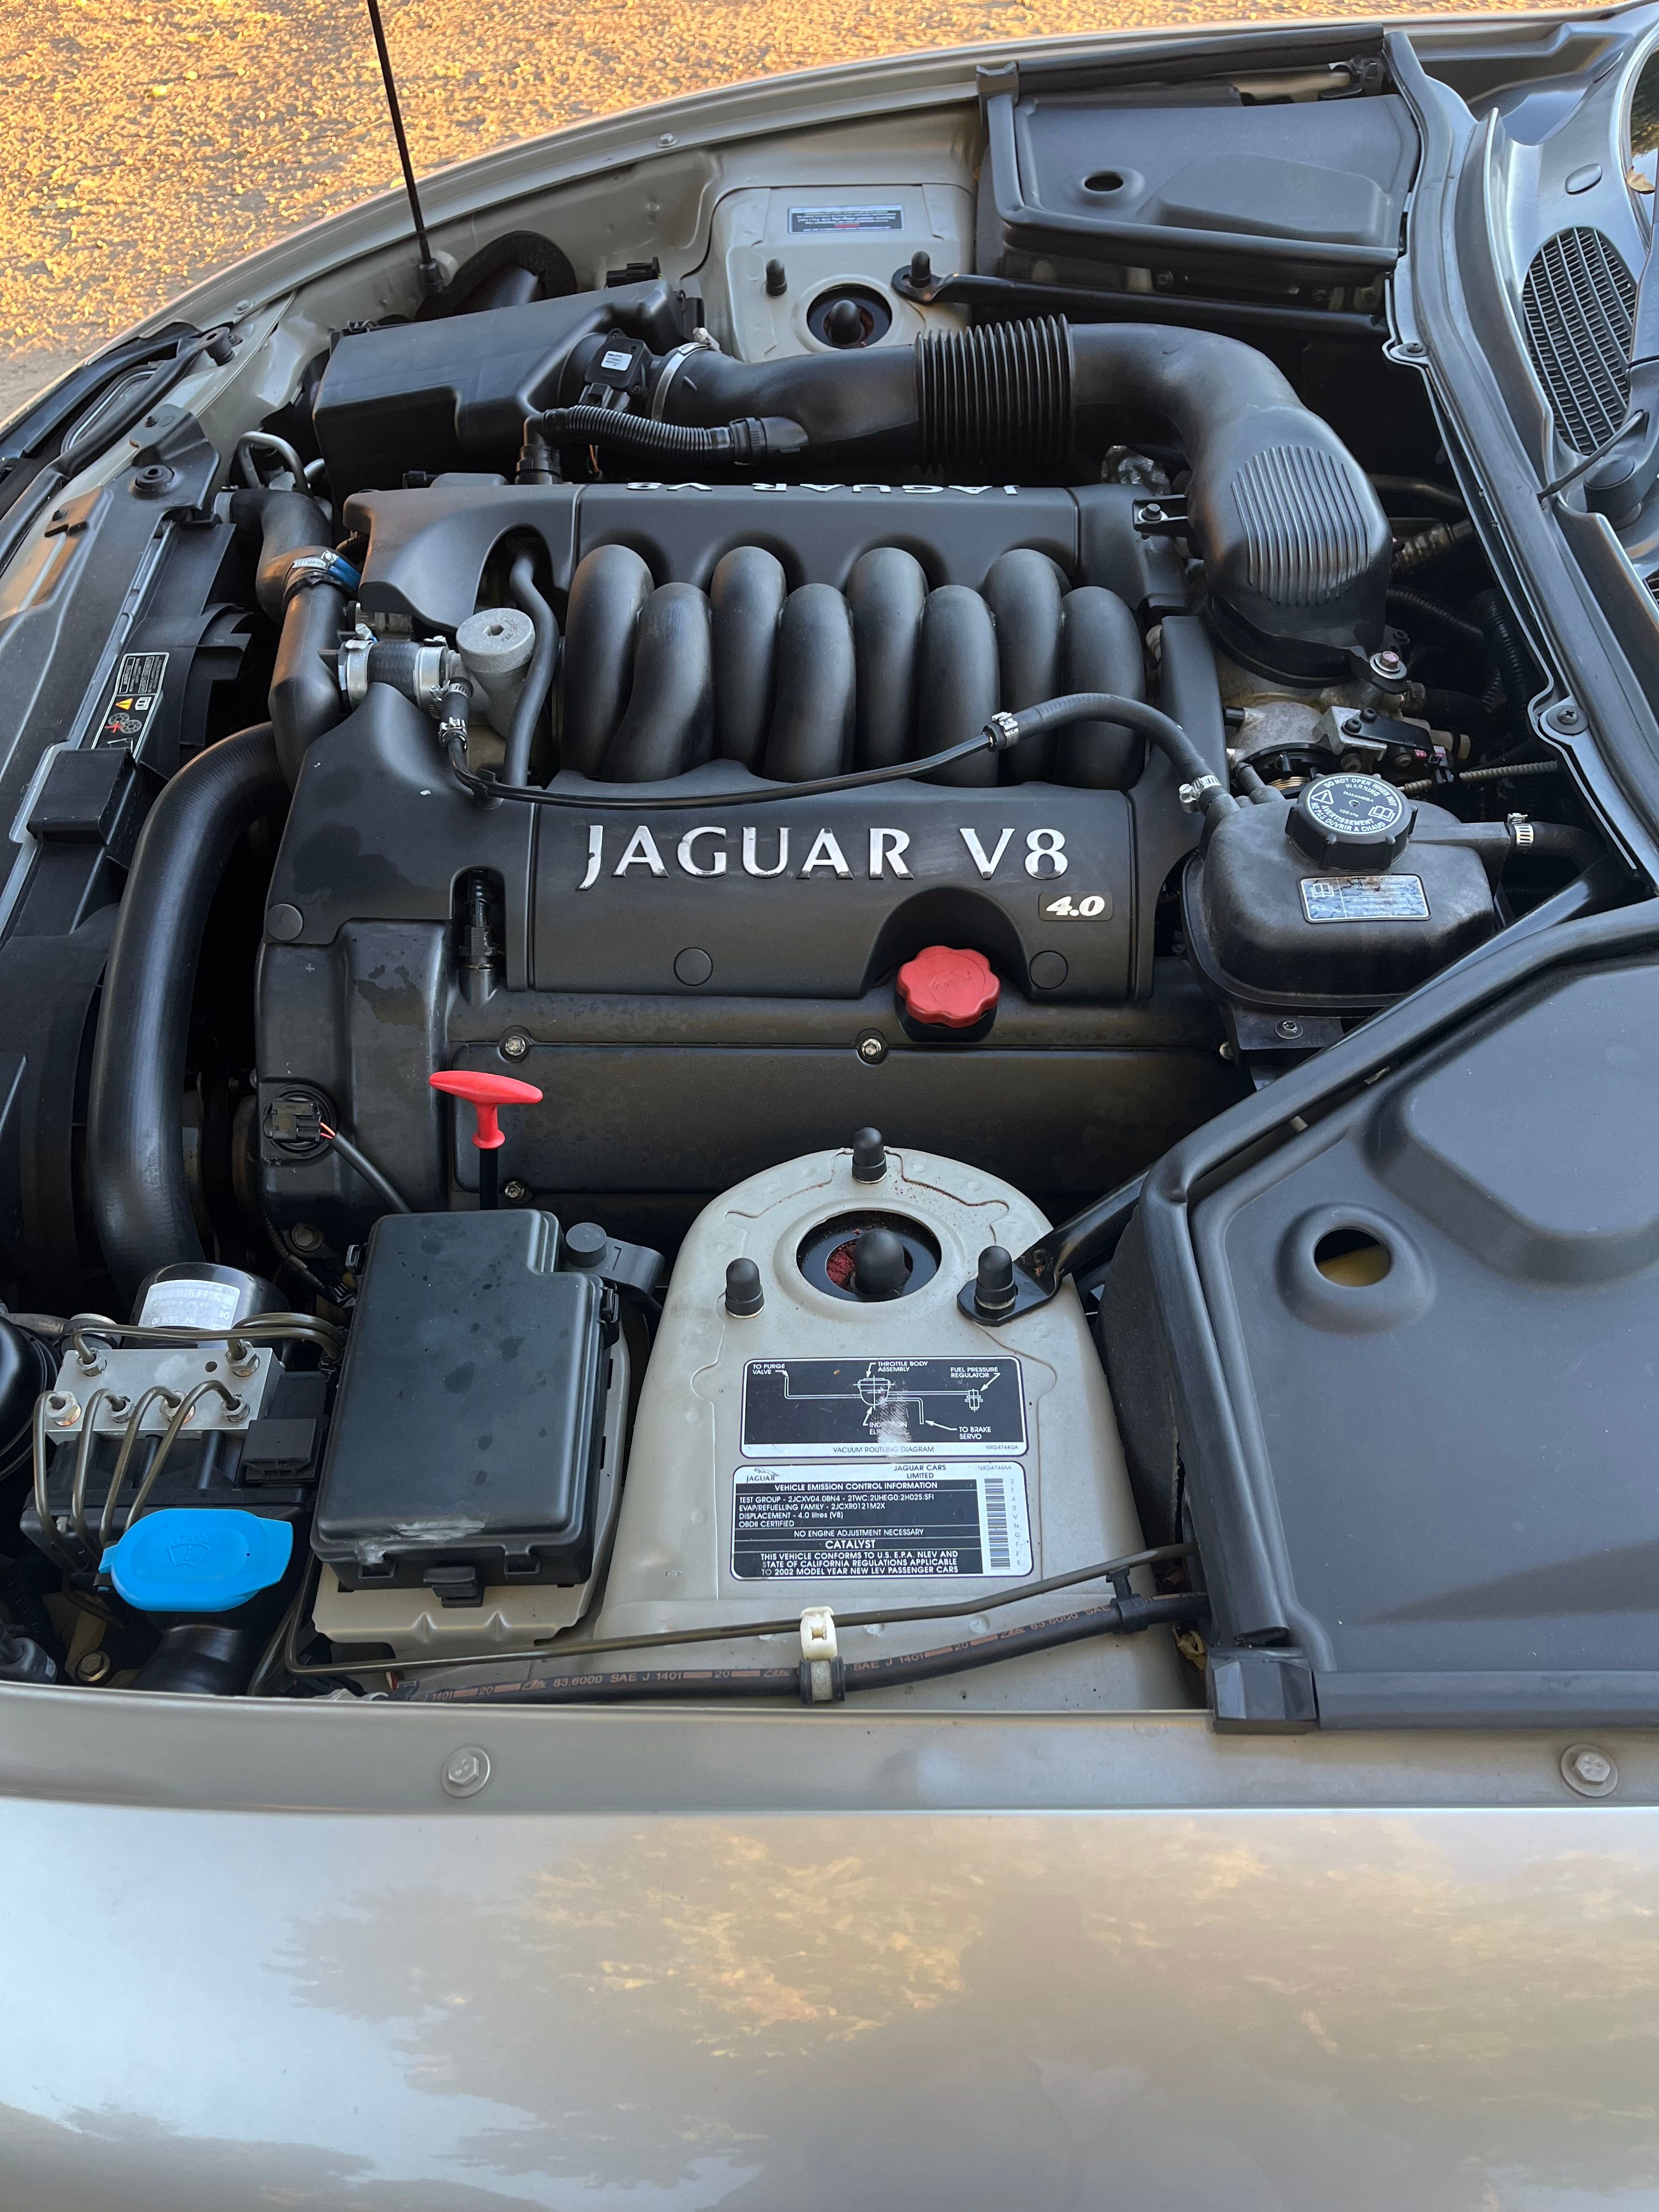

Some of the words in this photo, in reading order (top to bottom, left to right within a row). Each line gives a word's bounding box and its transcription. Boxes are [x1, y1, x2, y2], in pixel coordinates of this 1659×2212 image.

[1345, 783, 1380, 797] WARNING
[1351, 777, 1372, 786] OPEN
[1372, 783, 1391, 797] WHEN
[1386, 795, 1397, 807] HOT
[1321, 804, 1375, 826] AVERTISSEMENT
[1314, 809, 1328, 820] PAS
[1325, 818, 1353, 832] OUVRIR
[1361, 822, 1387, 832] CHAUD
[575, 825, 915, 891] JAGUAR
[958, 827, 1069, 881] V8
[1045, 895, 1106, 917] 4.0
[746, 1475, 776, 1483] JAGUAR
[884, 1481, 938, 1489] INFORMATION
[739, 1504, 798, 1512] EVAP/REFUELLING
[830, 1511, 843, 1520] (V8)
[884, 1528, 924, 1536] NECESSARY
[825, 1539, 876, 1549] CATALYST
[894, 1551, 915, 1559] E.P.A.
[852, 1559, 907, 1567] REGULATIONS
[910, 1558, 957, 1566] APPLICABLE
[888, 1566, 934, 1574] PASSENGER
[432, 1691, 454, 1701] 1401
[478, 1686, 493, 1695] 20
[553, 1675, 602, 1688] 83.6000
[610, 1673, 637, 1683] SAE
[642, 1673, 650, 1681] J
[657, 1672, 682, 1681] 1401
[714, 1671, 730, 1679] 20
[854, 1662, 879, 1672] SAE
[955, 1642, 968, 1651] 20
